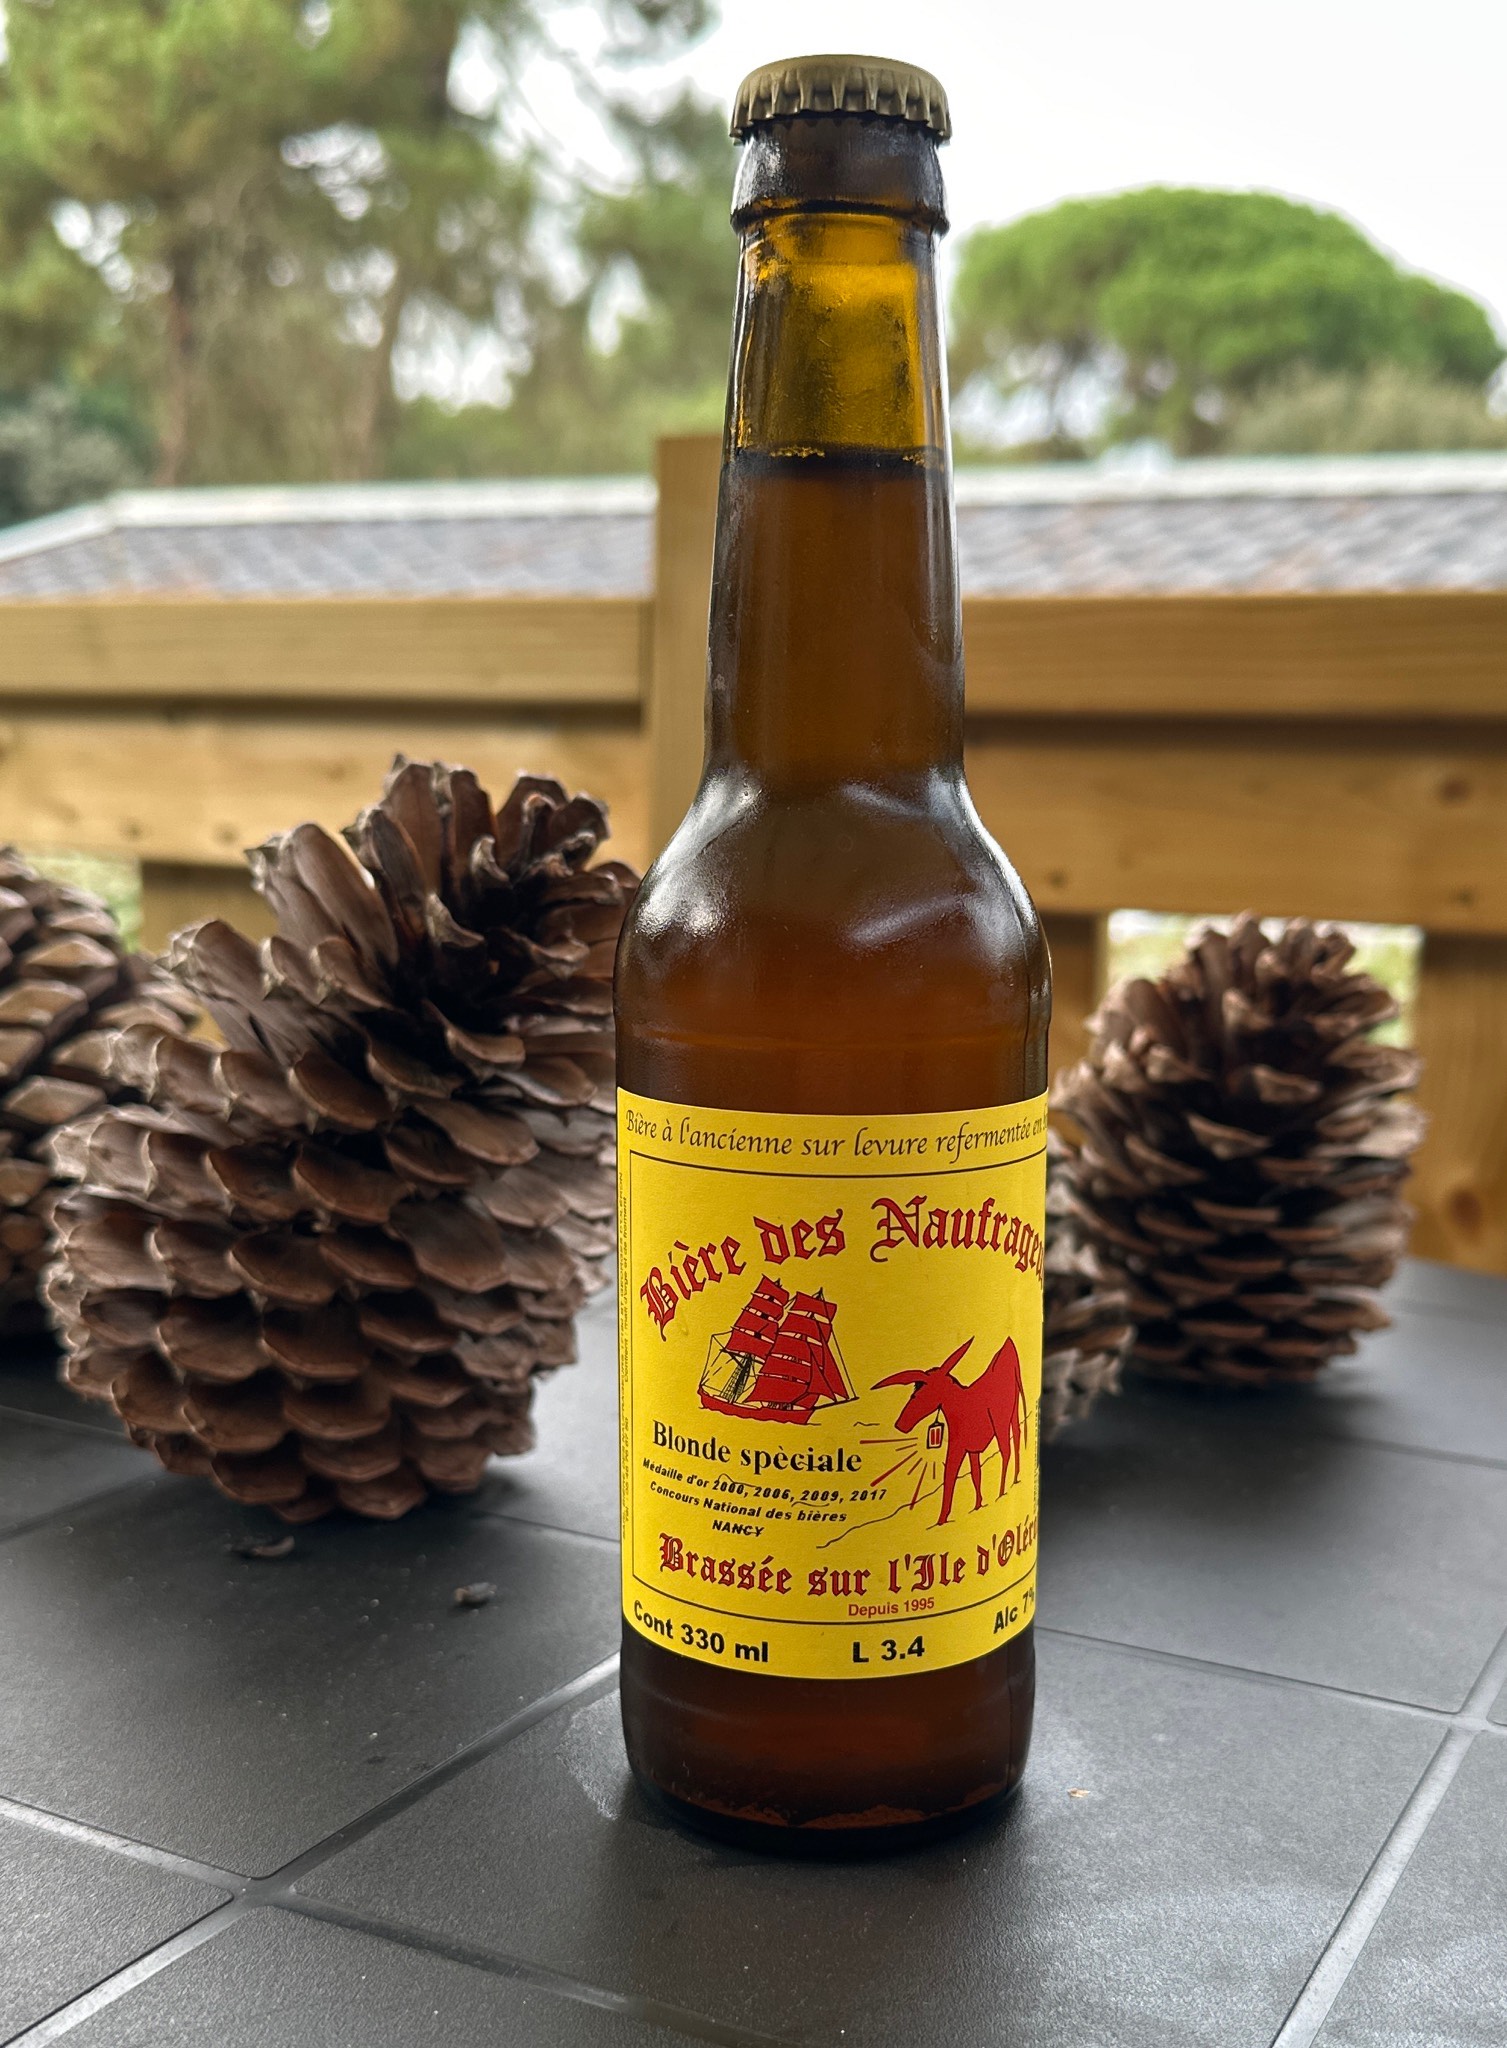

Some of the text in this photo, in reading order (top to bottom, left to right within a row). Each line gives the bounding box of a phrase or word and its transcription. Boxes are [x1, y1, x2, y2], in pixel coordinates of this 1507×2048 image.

[625, 1109, 657, 1141] Bière
[661, 1122, 673, 1143] à
[678, 1116, 793, 1155] l'ancienne
[801, 1139, 846, 1158] sur
[854, 1126, 928, 1158] levure
[936, 1116, 1031, 1165] refermentée
[1032, 1117, 1042, 1136] en
[640, 1240, 747, 1343] Bière
[753, 1208, 846, 1265] des
[652, 1419, 731, 1463] Blonde
[642, 1457, 684, 1483] Médaille
[686, 1474, 710, 1488] d'or
[753, 1486, 796, 1503] 2006,
[801, 1490, 845, 1505] 2009,
[850, 1487, 887, 1502] 2017
[650, 1481, 848, 1523] Concours National des bières
[711, 1519, 766, 1538] NANCY
[659, 1532, 792, 1595] Brassée
[807, 1566, 871, 1597] sur
[848, 1596, 935, 1619] Depuis 1995
[993, 1605, 1018, 1635] Alc
[634, 1599, 769, 1663] Cont 330 ml
[852, 1635, 925, 1663] L 3.4
